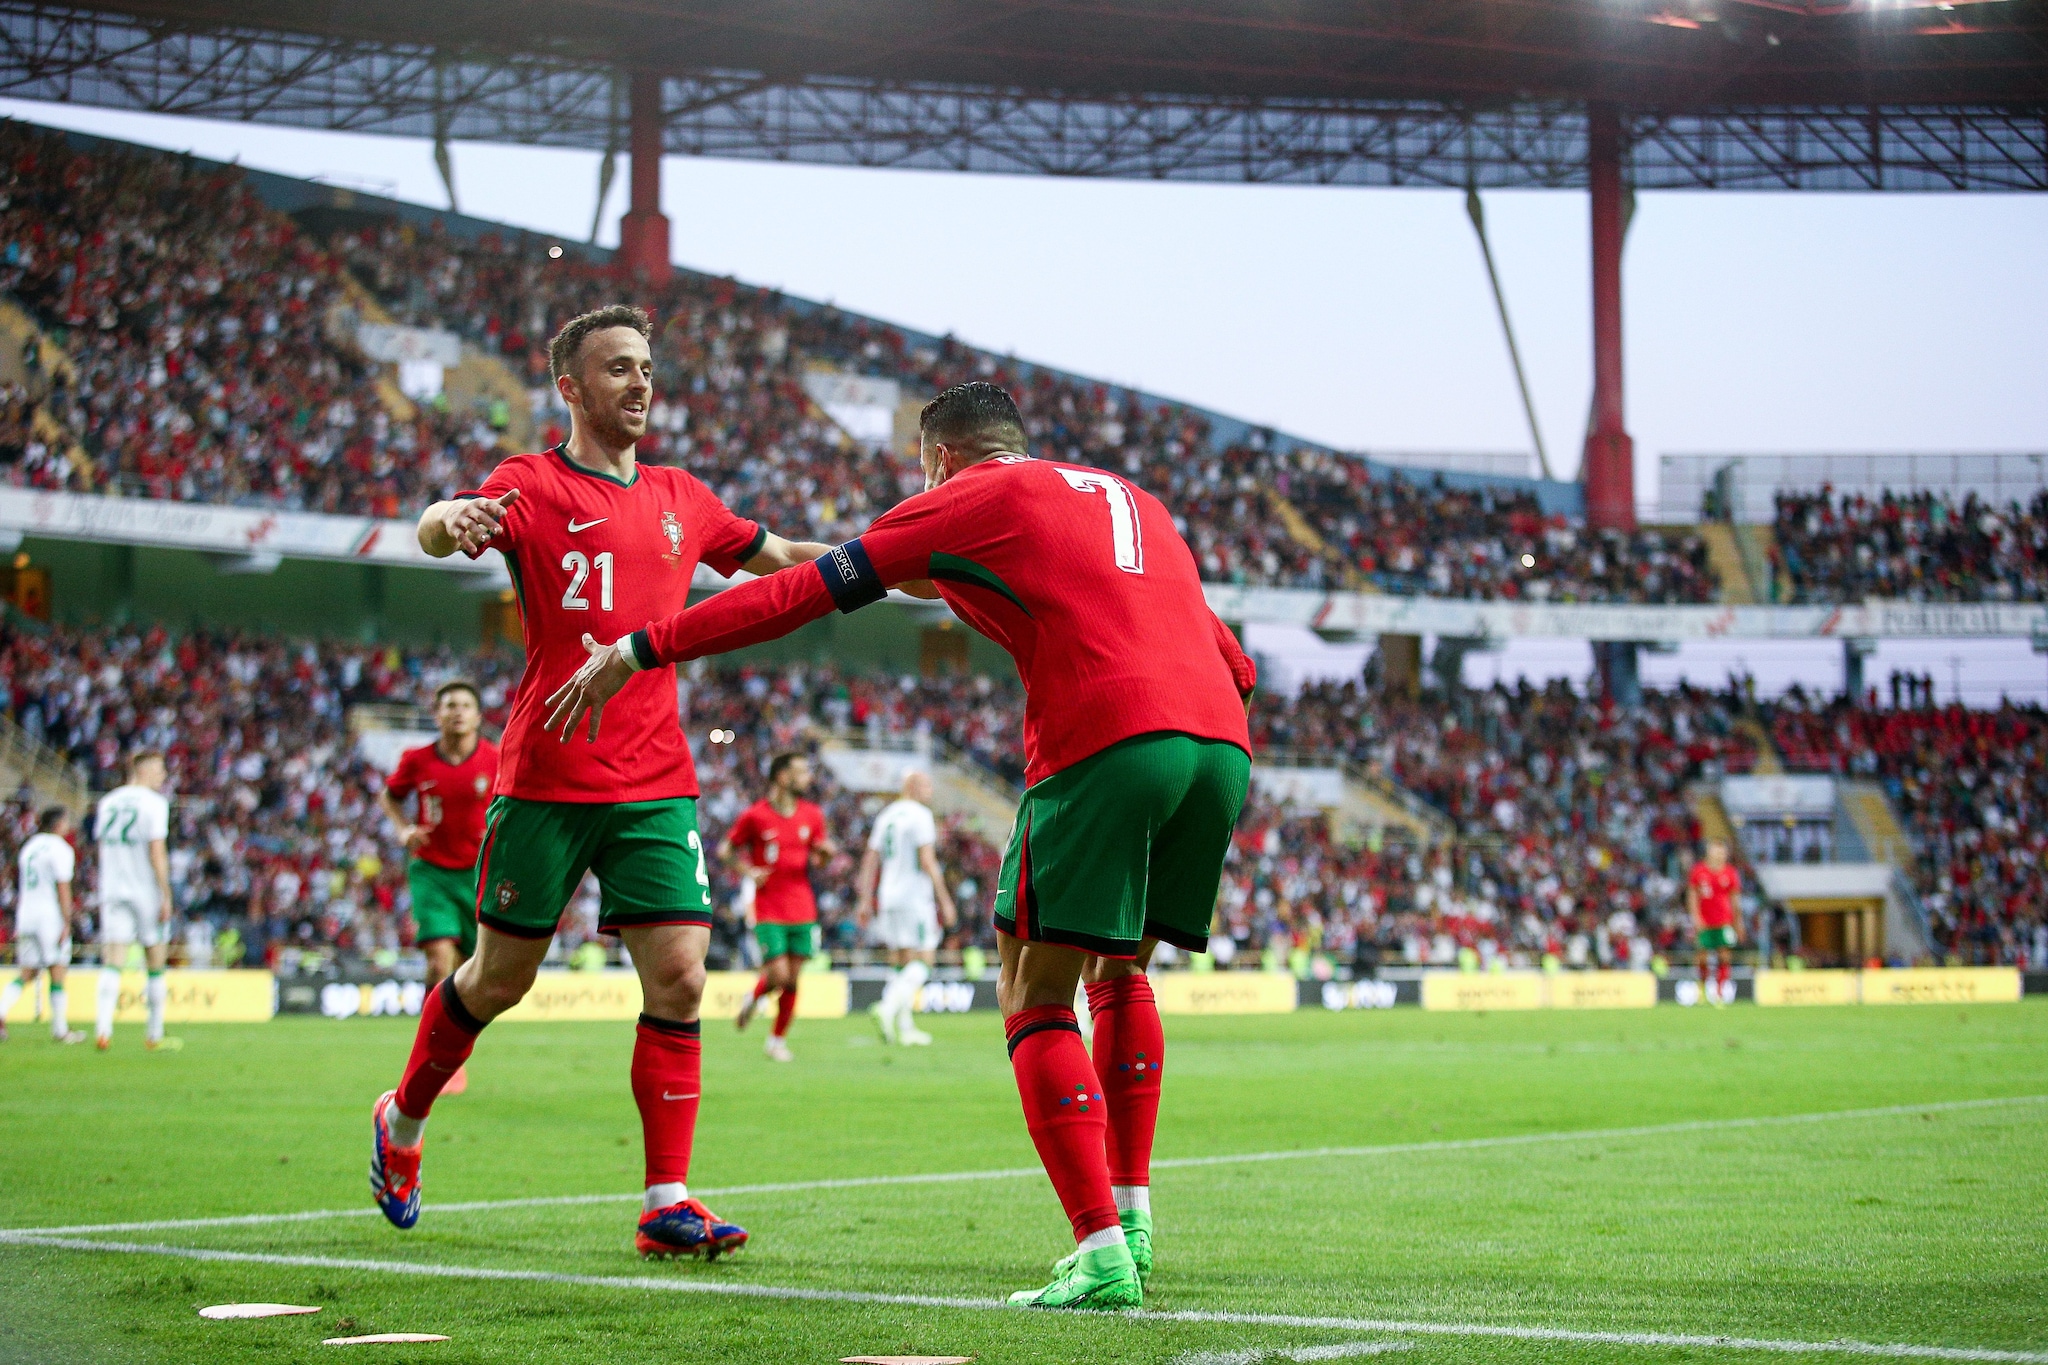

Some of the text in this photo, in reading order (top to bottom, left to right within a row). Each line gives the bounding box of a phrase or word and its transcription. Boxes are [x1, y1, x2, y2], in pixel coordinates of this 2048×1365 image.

[1054, 467, 1144, 575] 7
[561, 551, 614, 611] 21
[101, 805, 138, 847] 22
